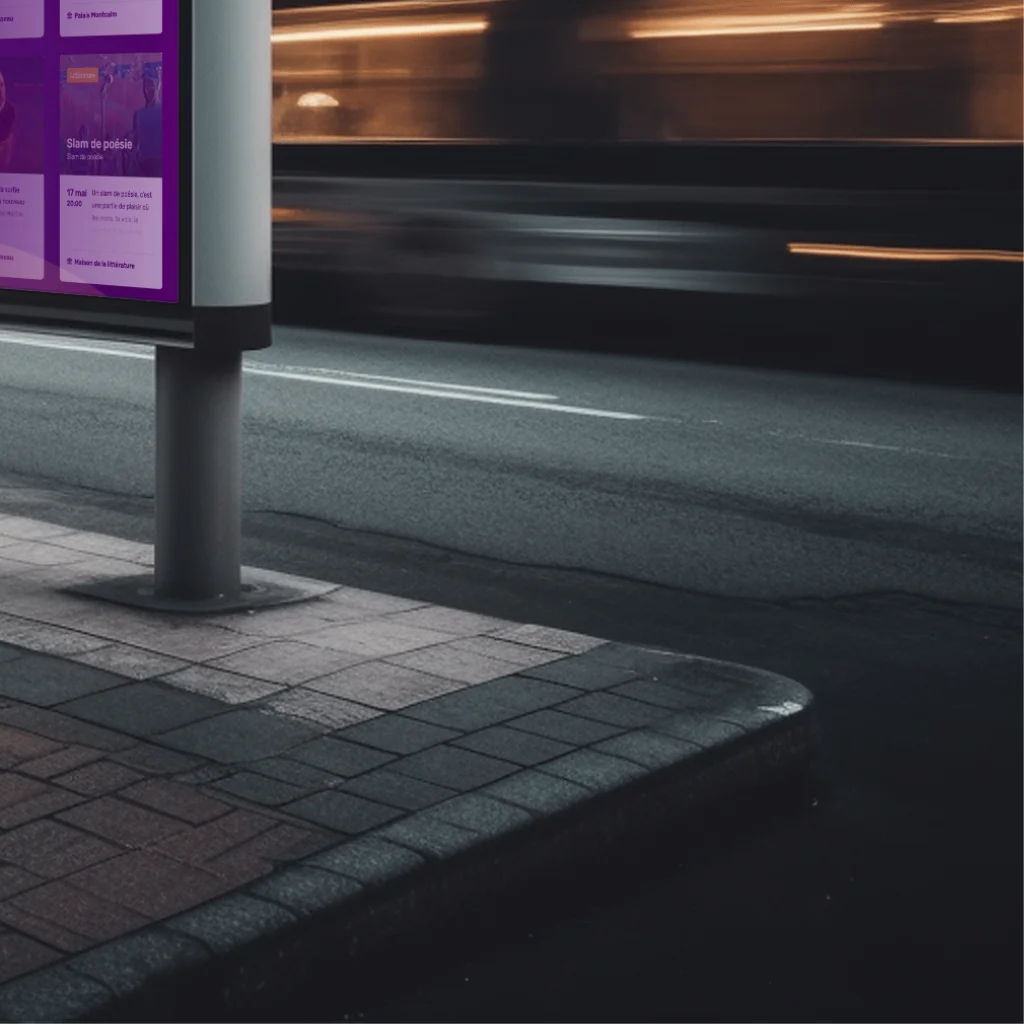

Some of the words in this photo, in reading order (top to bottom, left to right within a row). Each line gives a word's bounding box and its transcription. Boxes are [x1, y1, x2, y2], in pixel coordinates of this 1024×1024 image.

[66, 138, 88, 149] Slam
[90, 138, 102, 149] de
[103, 138, 133, 151] poésie
[66, 188, 74, 197] 17
[74, 189, 87, 197] mai
[74, 258, 92, 266] Maison
[93, 259, 101, 267] de
[107, 260, 136, 270] littérature
